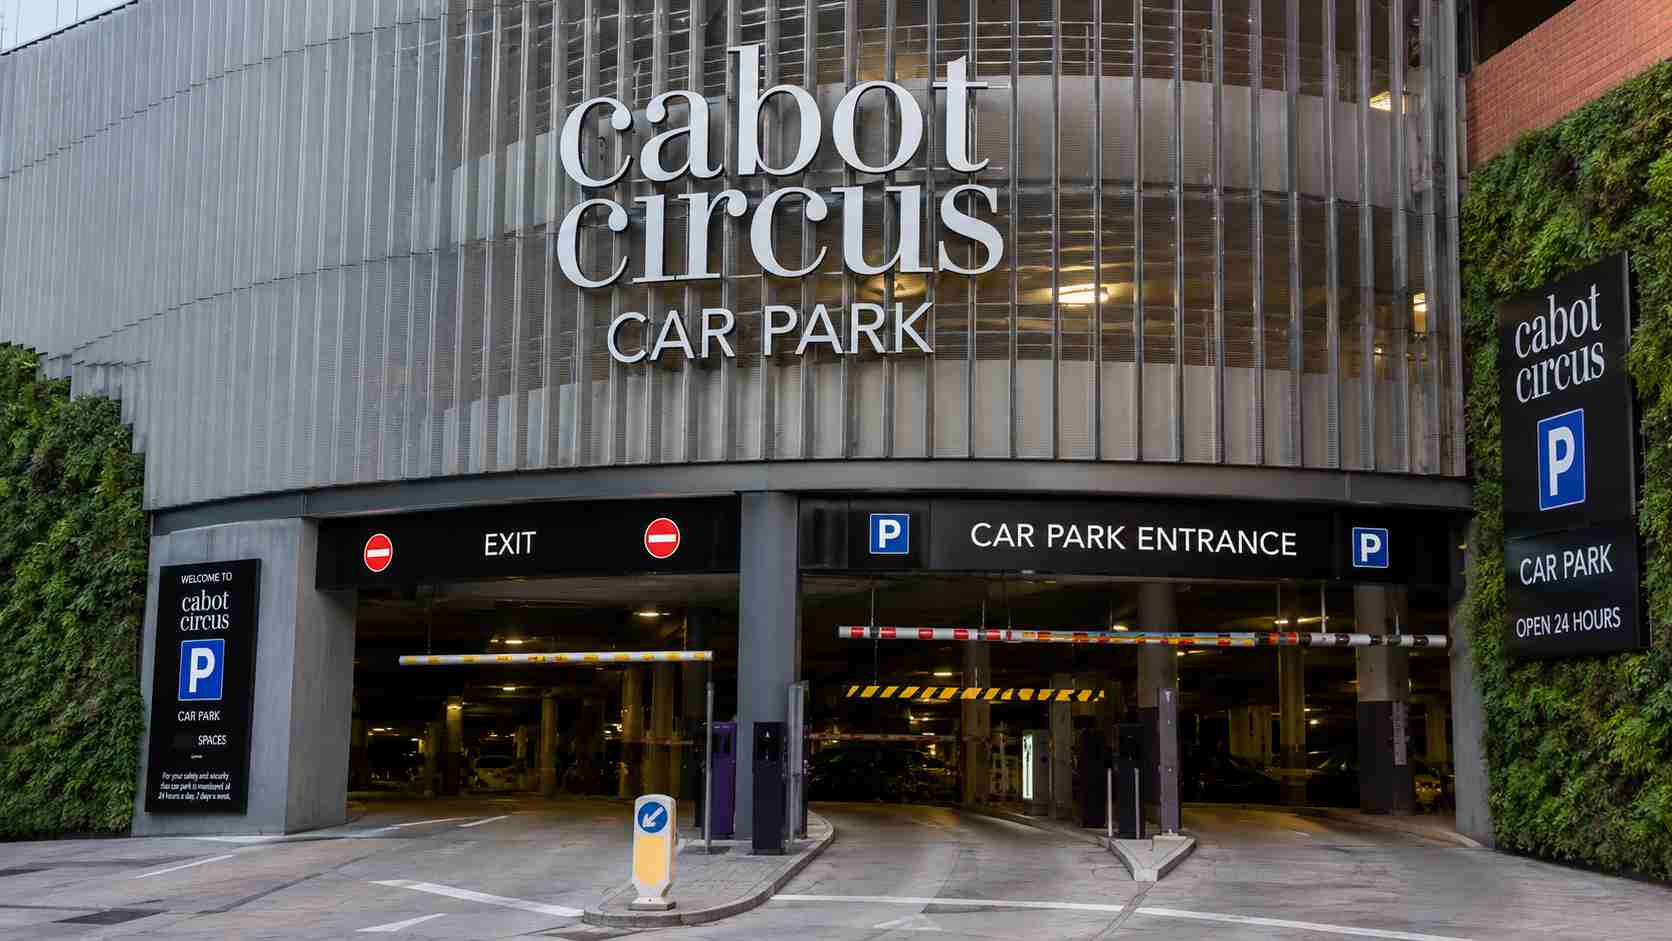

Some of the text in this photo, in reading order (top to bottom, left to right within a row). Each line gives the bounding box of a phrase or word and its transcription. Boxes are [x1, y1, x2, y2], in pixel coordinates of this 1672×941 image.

[559, 44, 989, 188] cabot
[556, 183, 1005, 289] circus
[607, 301, 935, 364] CAR PARK
[1515, 283, 1602, 359] cabot
[1516, 342, 1605, 403] circus
[1548, 426, 1575, 497] P
[484, 531, 537, 556] EXIT
[878, 519, 901, 549] P
[970, 522, 1297, 556] CAR PARK ENTRANCE
[1360, 533, 1383, 562] P
[181, 571, 233, 584] WELCOME TO
[1520, 543, 1613, 585] CAR PARK
[182, 589, 229, 612] cabot
[180, 613, 229, 631] circus
[1516, 606, 1621, 638] OPEN 24 HOURS
[188, 647, 216, 693] P
[178, 710, 221, 721] CAR PARK
[198, 735, 227, 745] SPACES
